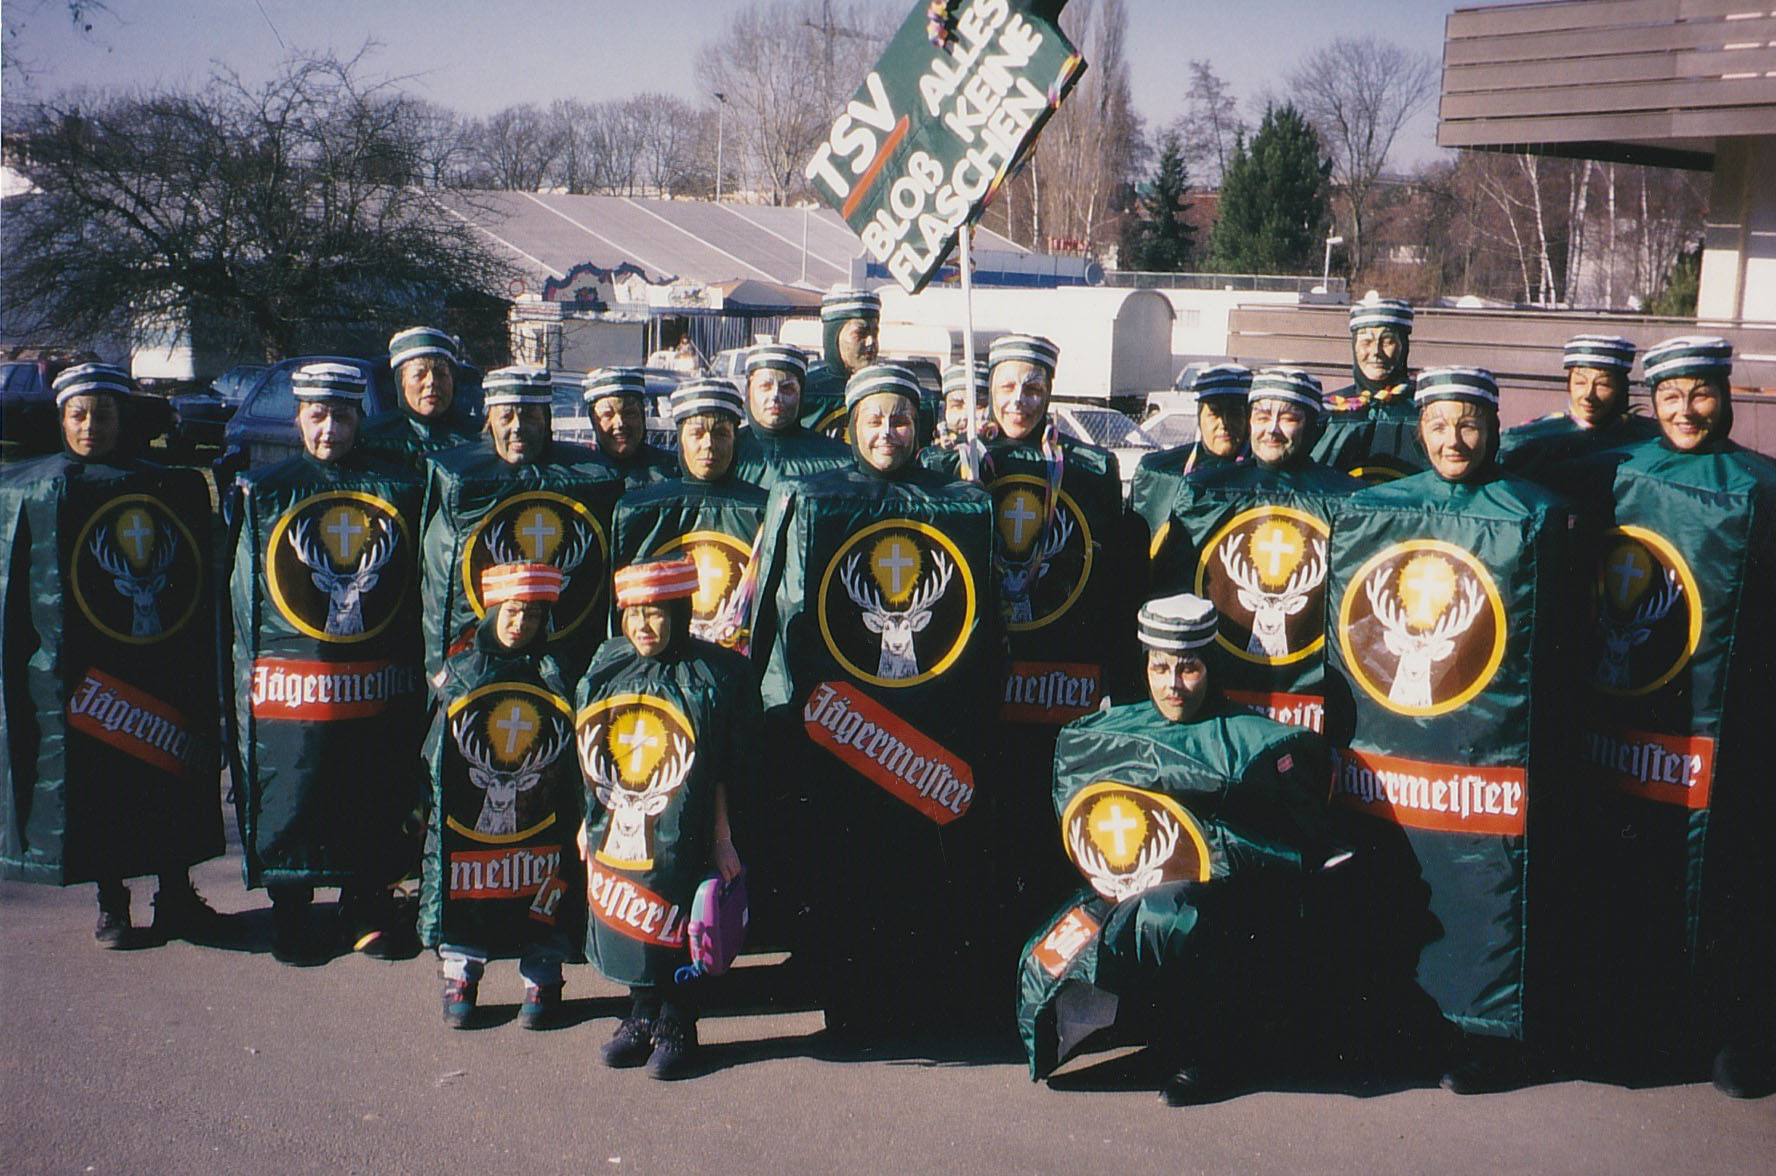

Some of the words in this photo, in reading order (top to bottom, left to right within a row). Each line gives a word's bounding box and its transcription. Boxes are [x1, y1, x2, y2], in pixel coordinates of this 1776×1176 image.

[919, 0, 1009, 117] ALLES
[945, 13, 1043, 143] KEINE
[805, 71, 896, 198] TSV
[888, 77, 1048, 293] FLASCHEN
